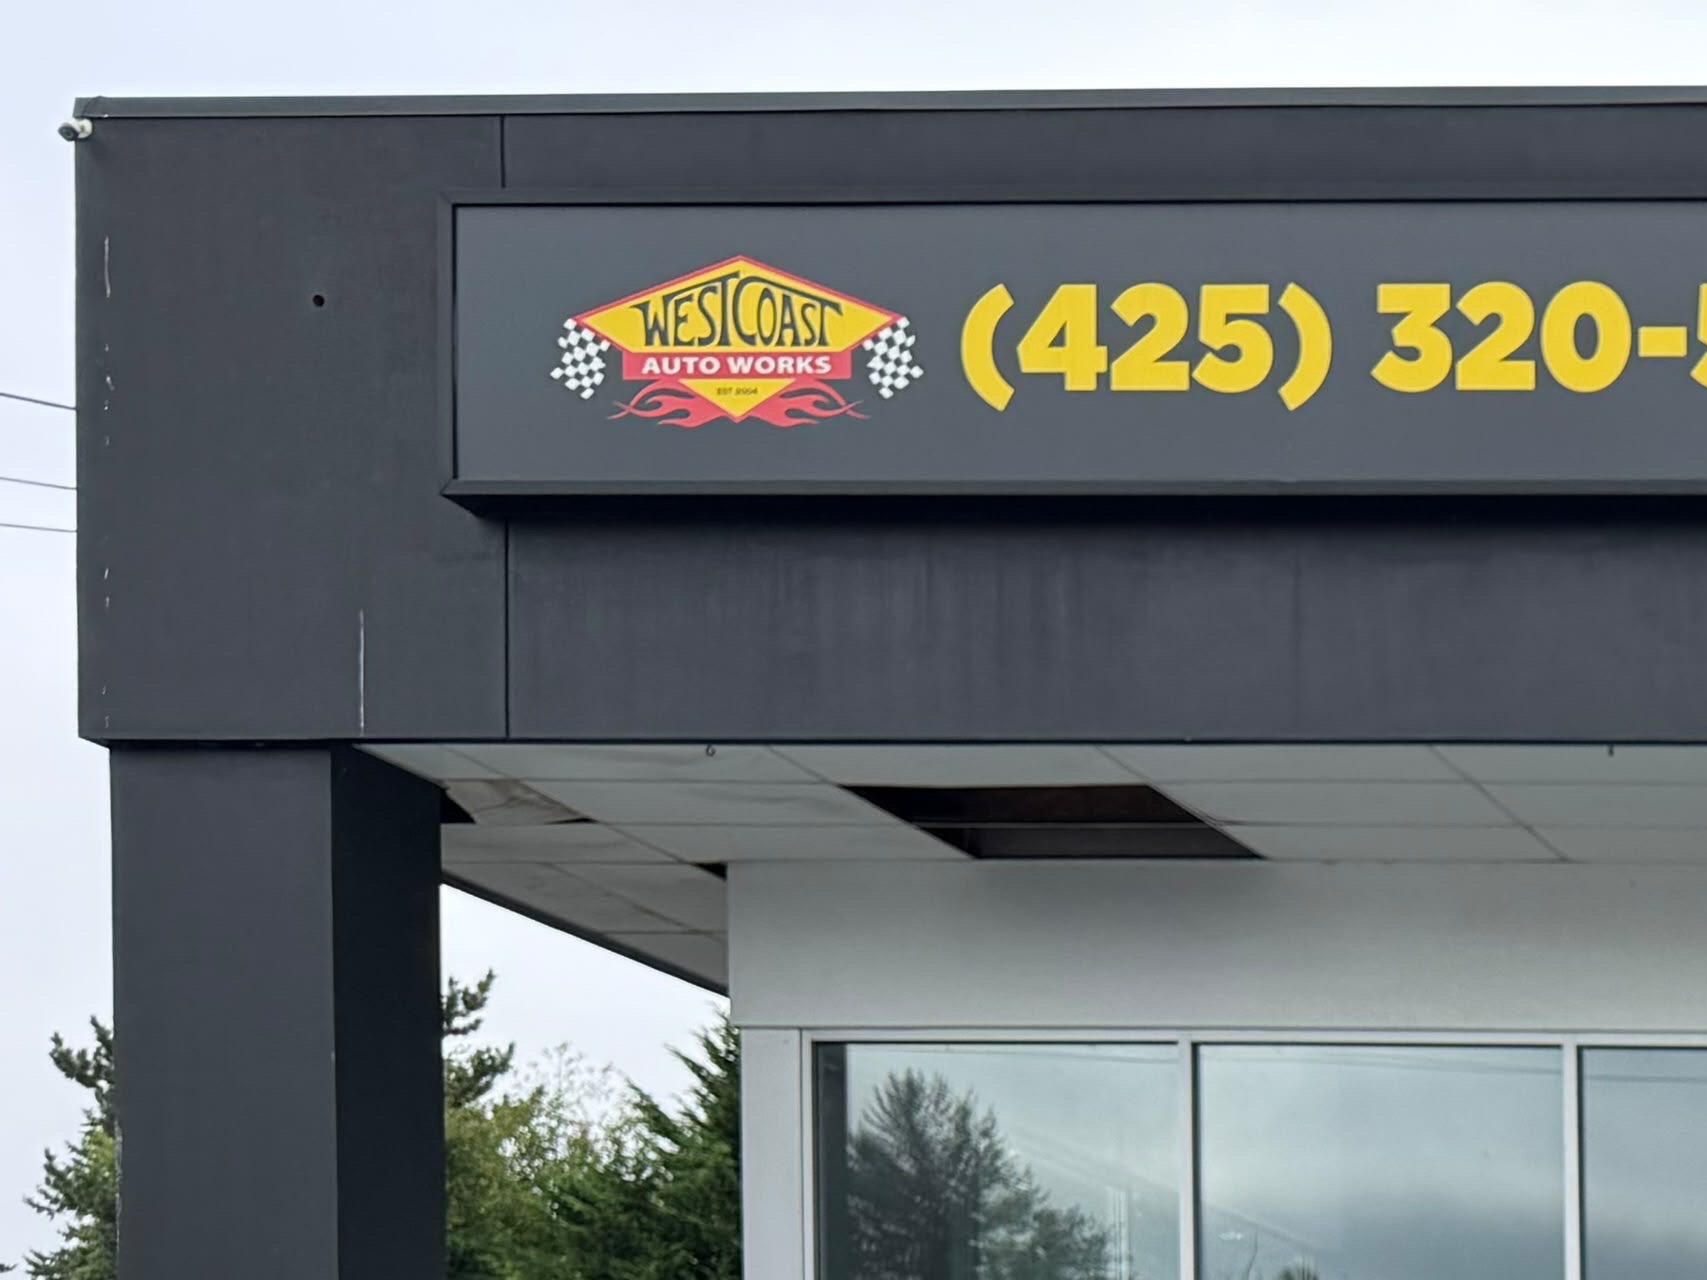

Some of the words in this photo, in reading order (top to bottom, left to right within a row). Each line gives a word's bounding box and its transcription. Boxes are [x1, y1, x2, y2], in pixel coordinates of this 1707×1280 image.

[641, 356, 721, 375] AUTO
[726, 355, 832, 375] WORKS
[962, 283, 1332, 411] (425)
